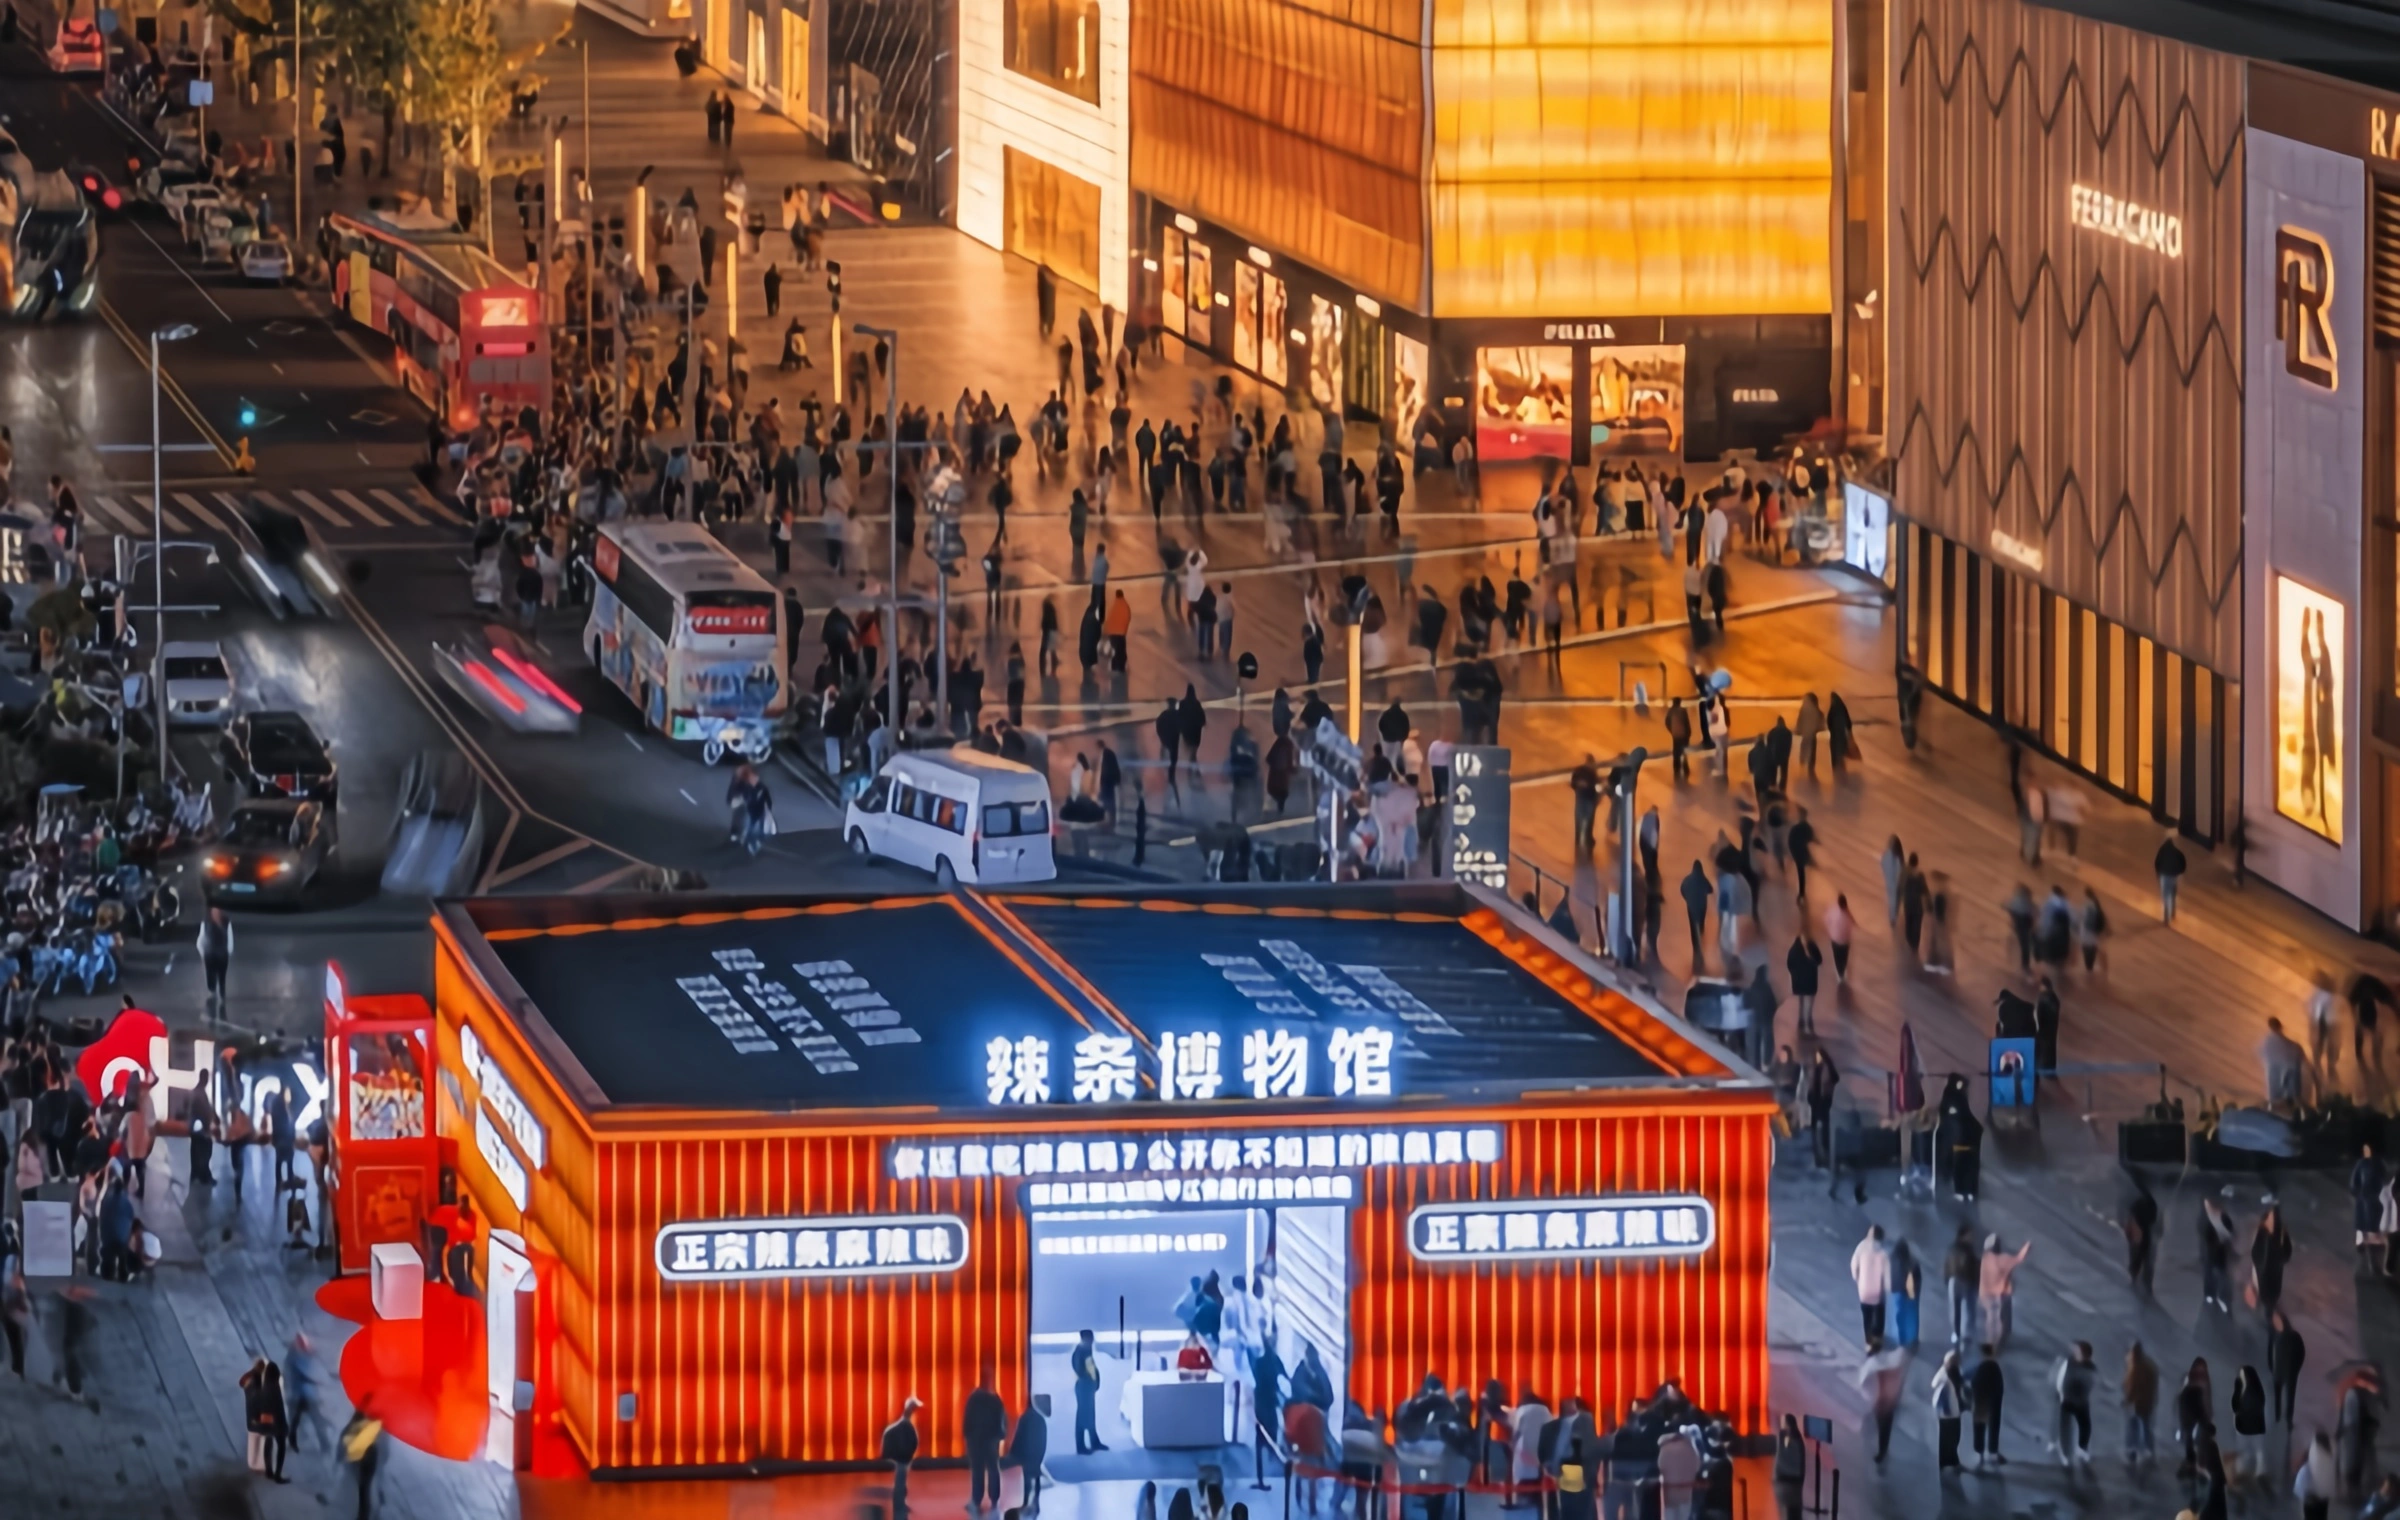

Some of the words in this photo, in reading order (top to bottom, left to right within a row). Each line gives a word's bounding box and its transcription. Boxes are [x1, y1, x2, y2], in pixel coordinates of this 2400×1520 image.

[985, 1026, 1393, 1105] 辣条博物馆
